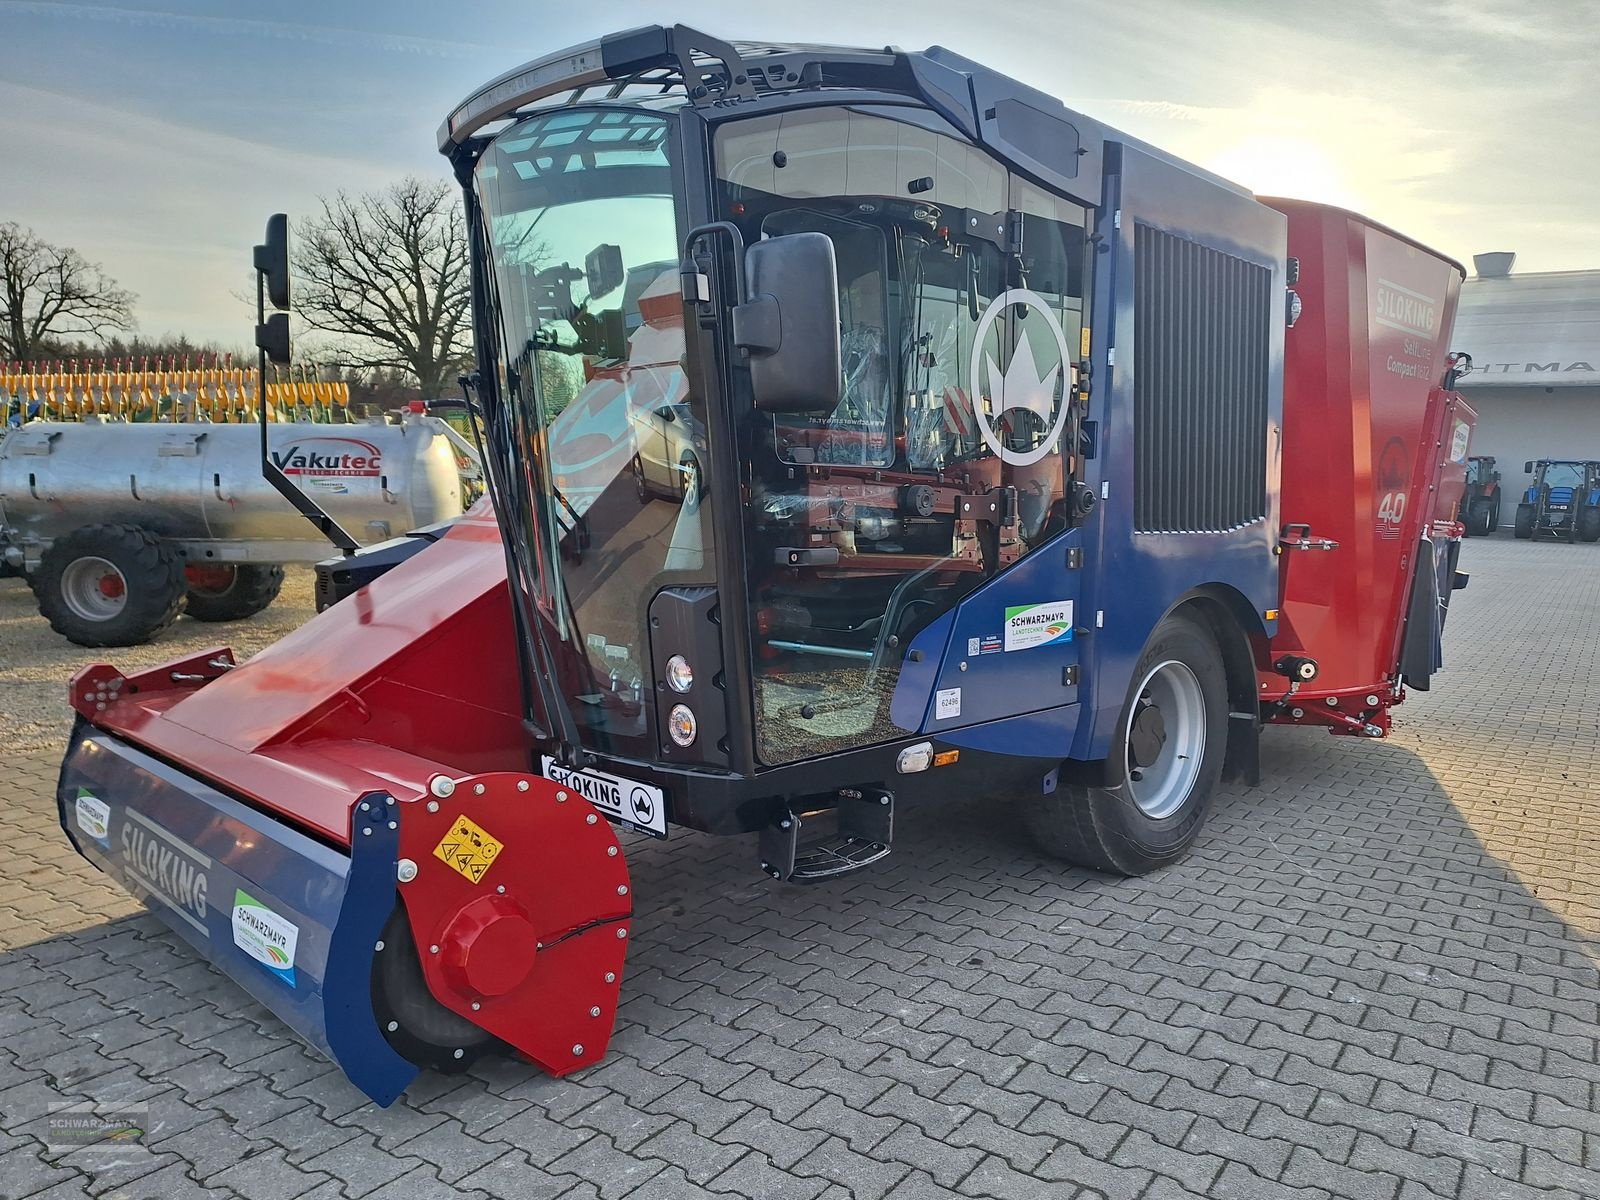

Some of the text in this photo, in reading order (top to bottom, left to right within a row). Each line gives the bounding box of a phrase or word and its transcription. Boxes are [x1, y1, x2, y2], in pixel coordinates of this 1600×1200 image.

[1376, 288, 1434, 331] SILOKING
[1386, 355, 1418, 379] Compact
[271, 446, 382, 471] Vakutec
[1011, 612, 1064, 627] SCHWARZMAYR
[1012, 626, 1044, 636] LANDTECHNIK
[941, 697, 958, 707] 62496
[121, 822, 207, 918] SILOKING
[238, 907, 287, 948] SCHWARZMAYR
